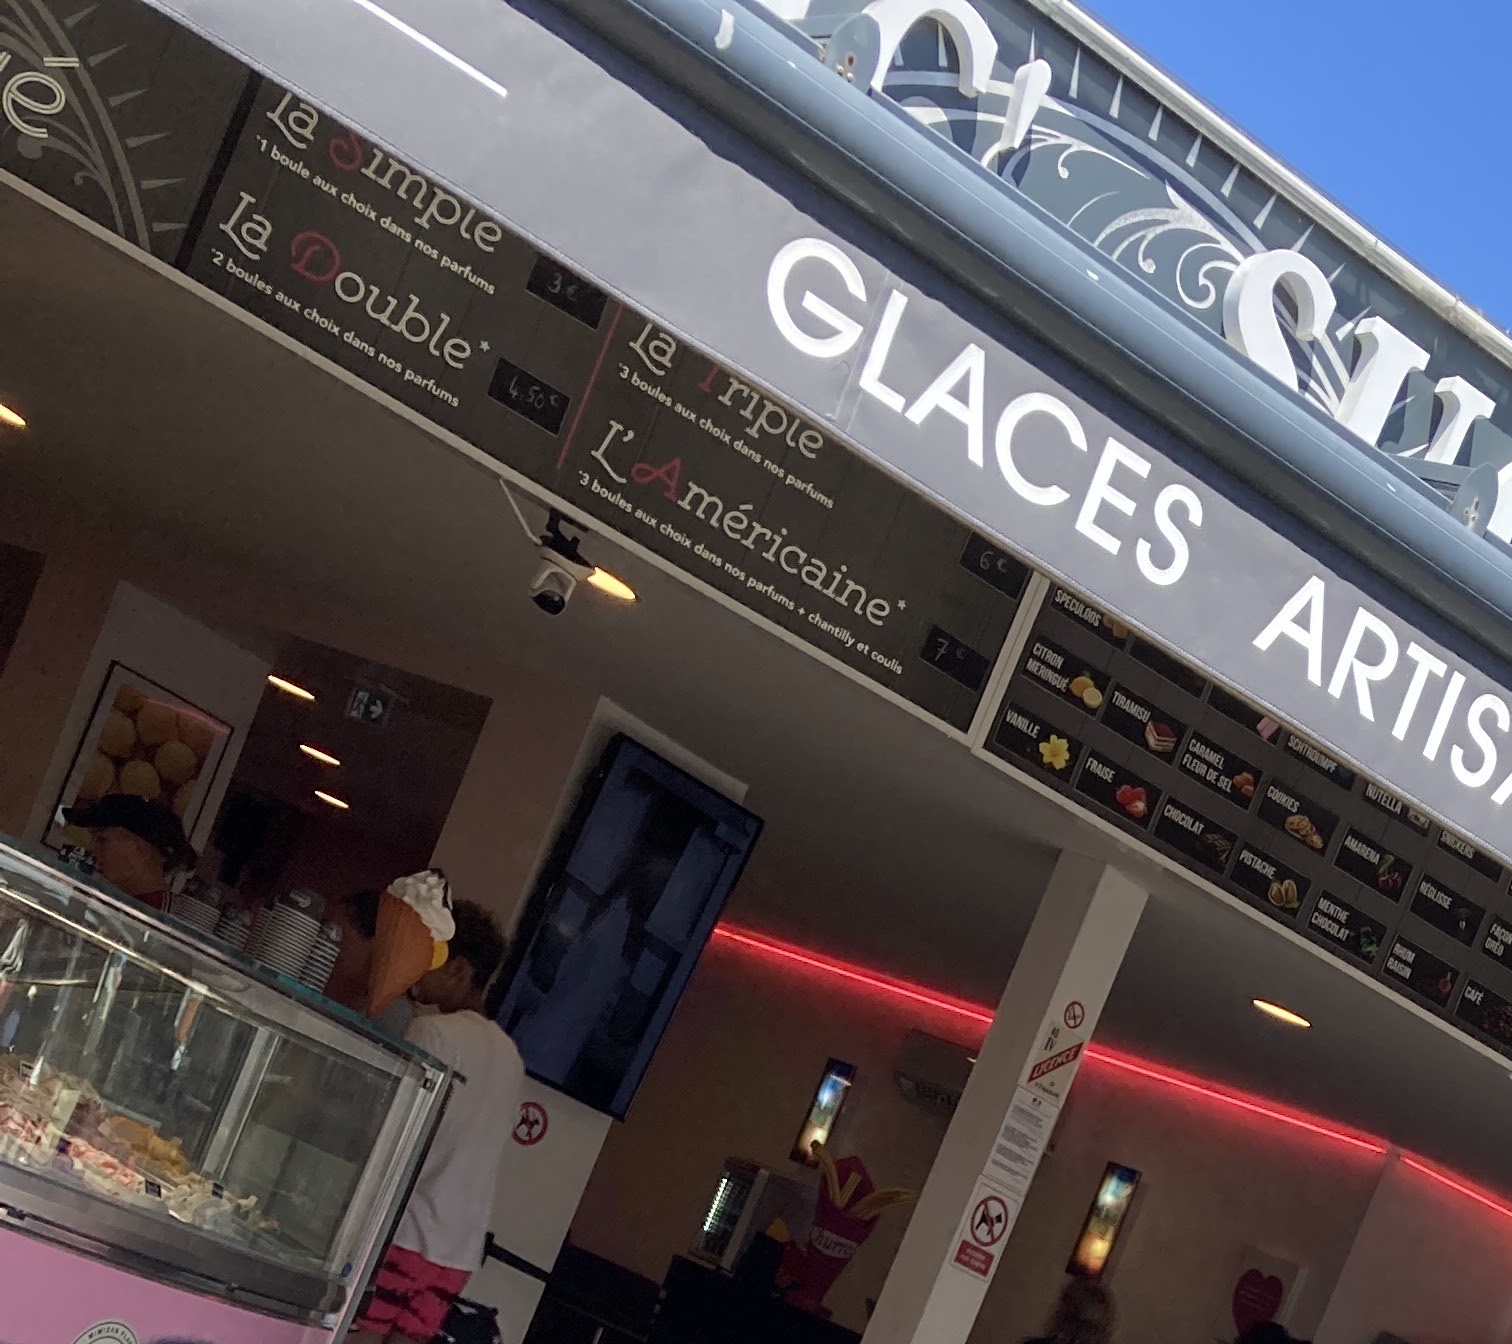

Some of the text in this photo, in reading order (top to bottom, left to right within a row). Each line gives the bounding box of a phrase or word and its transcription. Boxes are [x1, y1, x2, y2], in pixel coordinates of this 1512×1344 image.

[219, 191, 272, 260] La
[270, 145, 495, 295] boule aux choix dans nos parfums
[226, 260, 459, 408] boules aux choix dans nos parfums
[767, 237, 1202, 586] GLACES
[631, 372, 835, 509] boules aux choix dans nos parfums
[591, 479, 904, 675] boules aux choix dans nos parfums chantilly et coulis
[1055, 589, 1102, 627] SPECULOOS
[1032, 642, 1065, 669] CITRON
[1025, 658, 1070, 692] MERINGUÉ
[1112, 691, 1151, 723] TIRAMISU
[1005, 709, 1041, 739] VANILLE
[1085, 757, 1116, 783] FRAISE
[1188, 739, 1225, 770] CARAMEL
[1287, 734, 1338, 774] SCHTROUMPF
[1182, 753, 1233, 793] FLEUR DE SEL
[1266, 785, 1300, 813] COOKIES
[1365, 783, 1403, 815] NUTELLA
[1164, 804, 1204, 836] CHOCOLAT
[1344, 835, 1381, 865] AMARENA
[1440, 829, 1476, 859] SNICKERS
[1239, 850, 1277, 880] PISTACHE
[1317, 897, 1350, 924] MENTHE
[1311, 912, 1350, 942] CHOCOLAT
[1464, 985, 1485, 1005] CAFÉ
[1031, 1044, 1080, 1080] LICENCE
